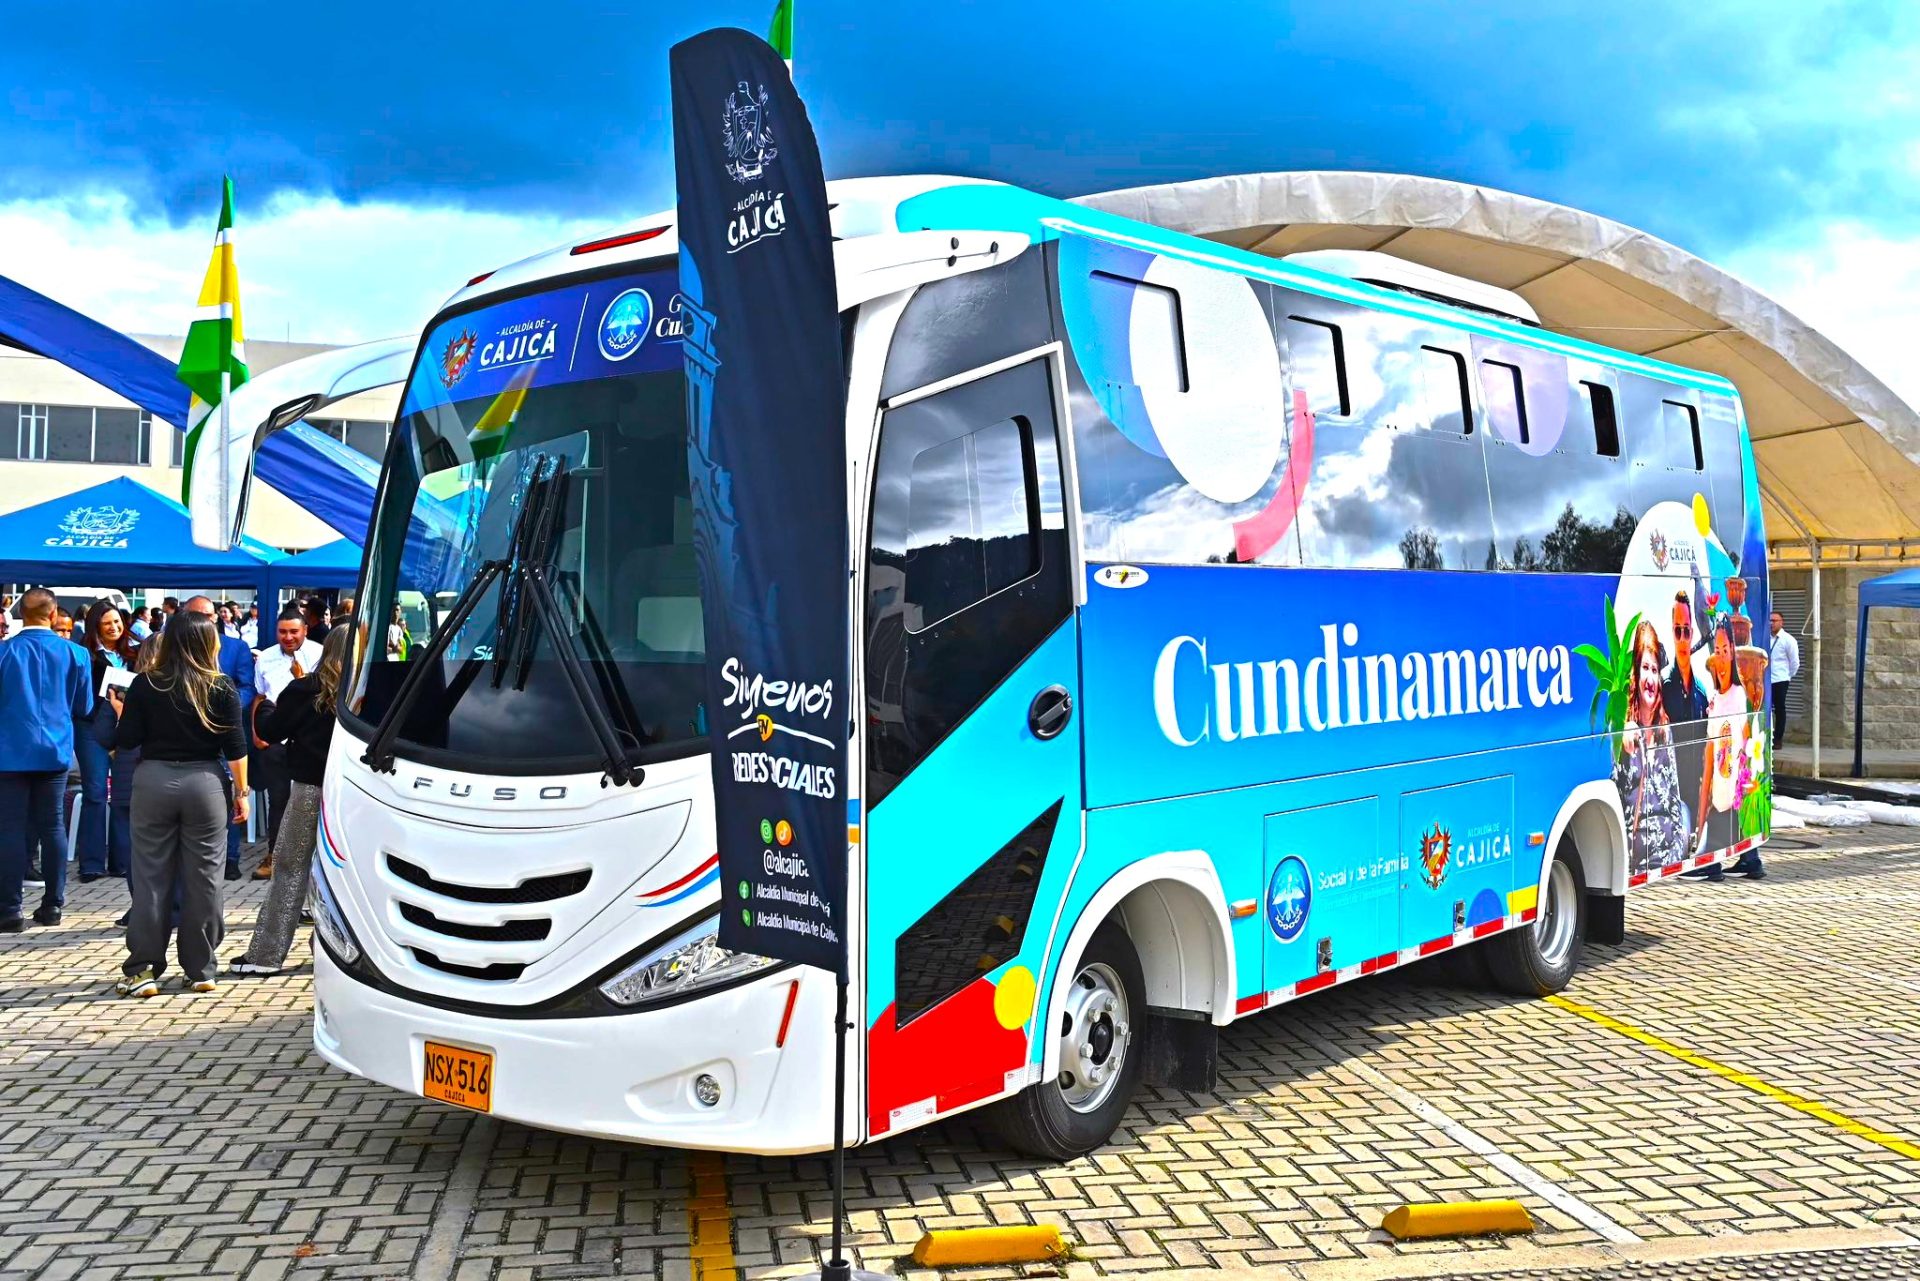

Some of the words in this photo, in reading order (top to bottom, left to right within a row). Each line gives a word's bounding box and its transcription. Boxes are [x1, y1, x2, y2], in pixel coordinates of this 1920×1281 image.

[501, 319, 534, 336] ALCALDÍA
[534, 319, 546, 329] DE
[480, 323, 558, 367] CAJICÁ
[1153, 622, 1574, 747] Cundinamarca
[731, 752, 769, 783] REDES
[413, 776, 568, 801] FUSO
[1456, 828, 1511, 868] CAJICÁ
[1318, 864, 1347, 891] Social
[756, 883, 781, 900] Alcaldía
[810, 891, 819, 908] de
[757, 911, 782, 929] Alcaldía
[426, 1051, 454, 1087] NSX
[457, 1058, 489, 1095] 516
